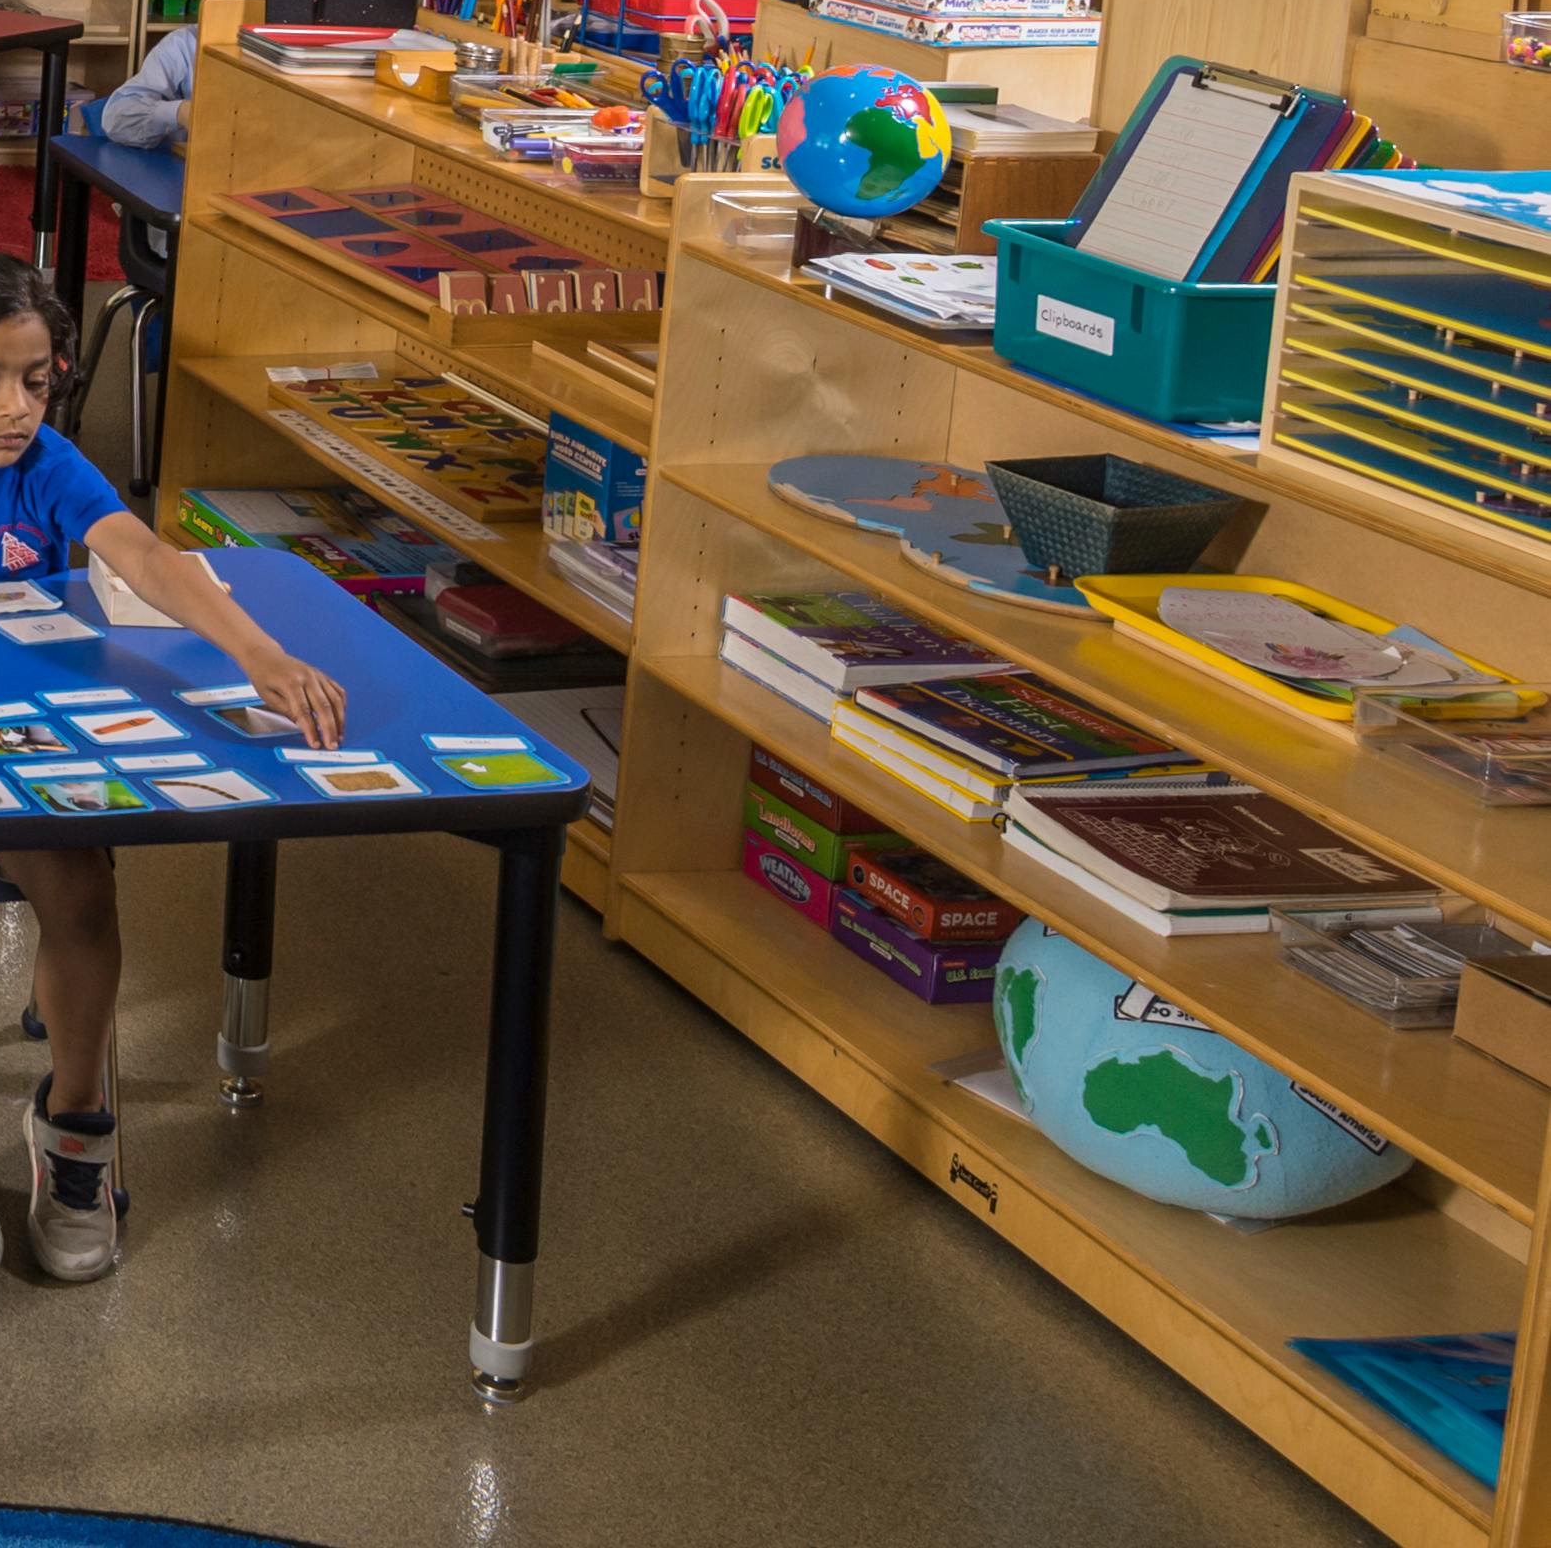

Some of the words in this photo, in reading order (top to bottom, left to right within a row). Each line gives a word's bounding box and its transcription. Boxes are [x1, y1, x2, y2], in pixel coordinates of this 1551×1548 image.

[1040, 307, 1104, 340] Clipboards
[940, 689, 1066, 748] Dictionary
[994, 694, 1072, 735] First
[1013, 687, 1121, 736] Scholastic
[759, 853, 812, 901] WEATHER
[868, 871, 912, 910] SPACE
[940, 911, 999, 928] SPACE
